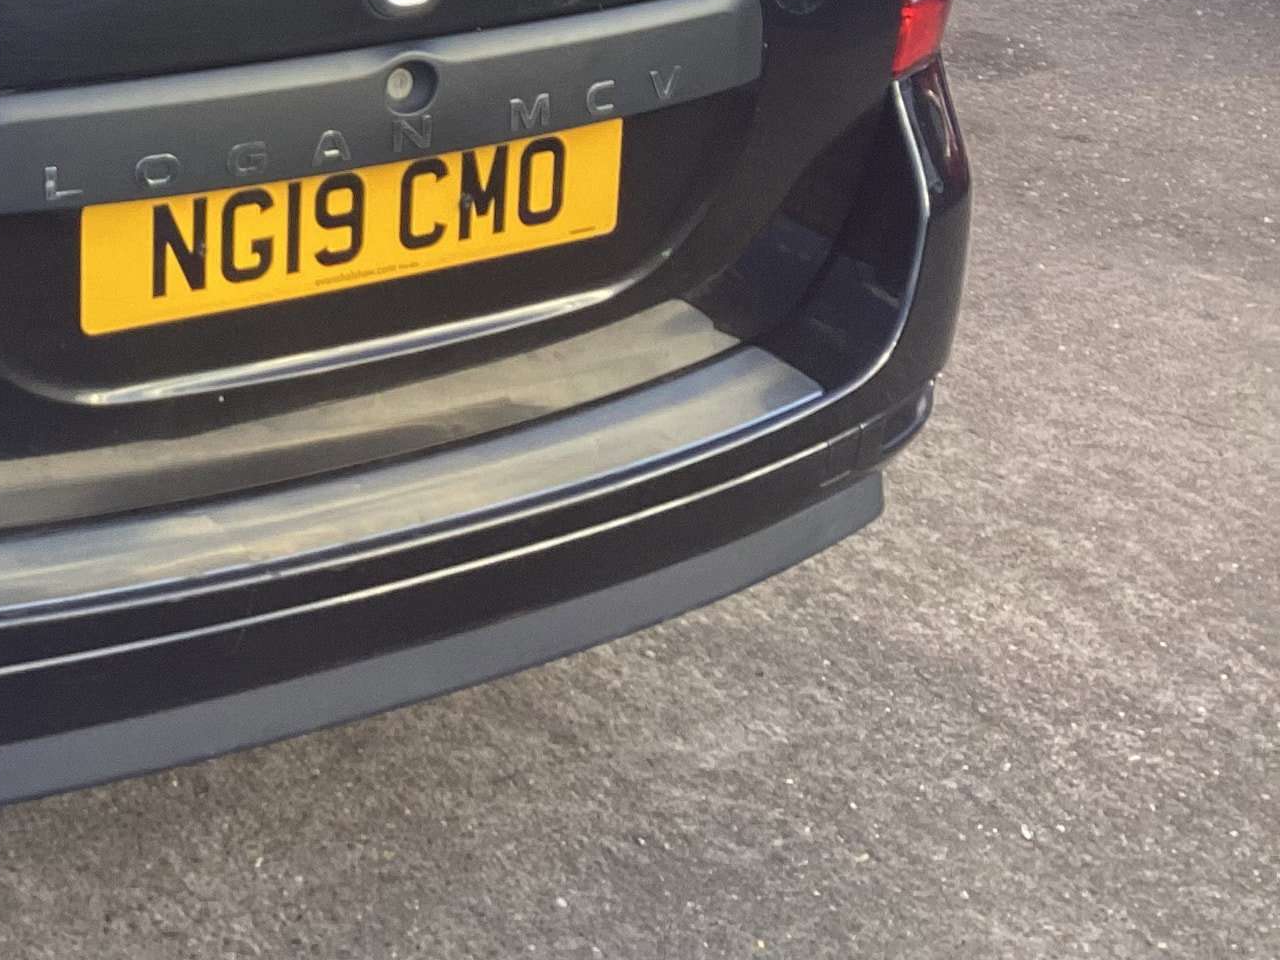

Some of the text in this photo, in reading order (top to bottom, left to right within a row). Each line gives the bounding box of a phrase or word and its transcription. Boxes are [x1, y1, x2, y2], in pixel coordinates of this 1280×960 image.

[45, 65, 681, 201] LOGAN MCV
[151, 136, 567, 299] NG19 CMO
